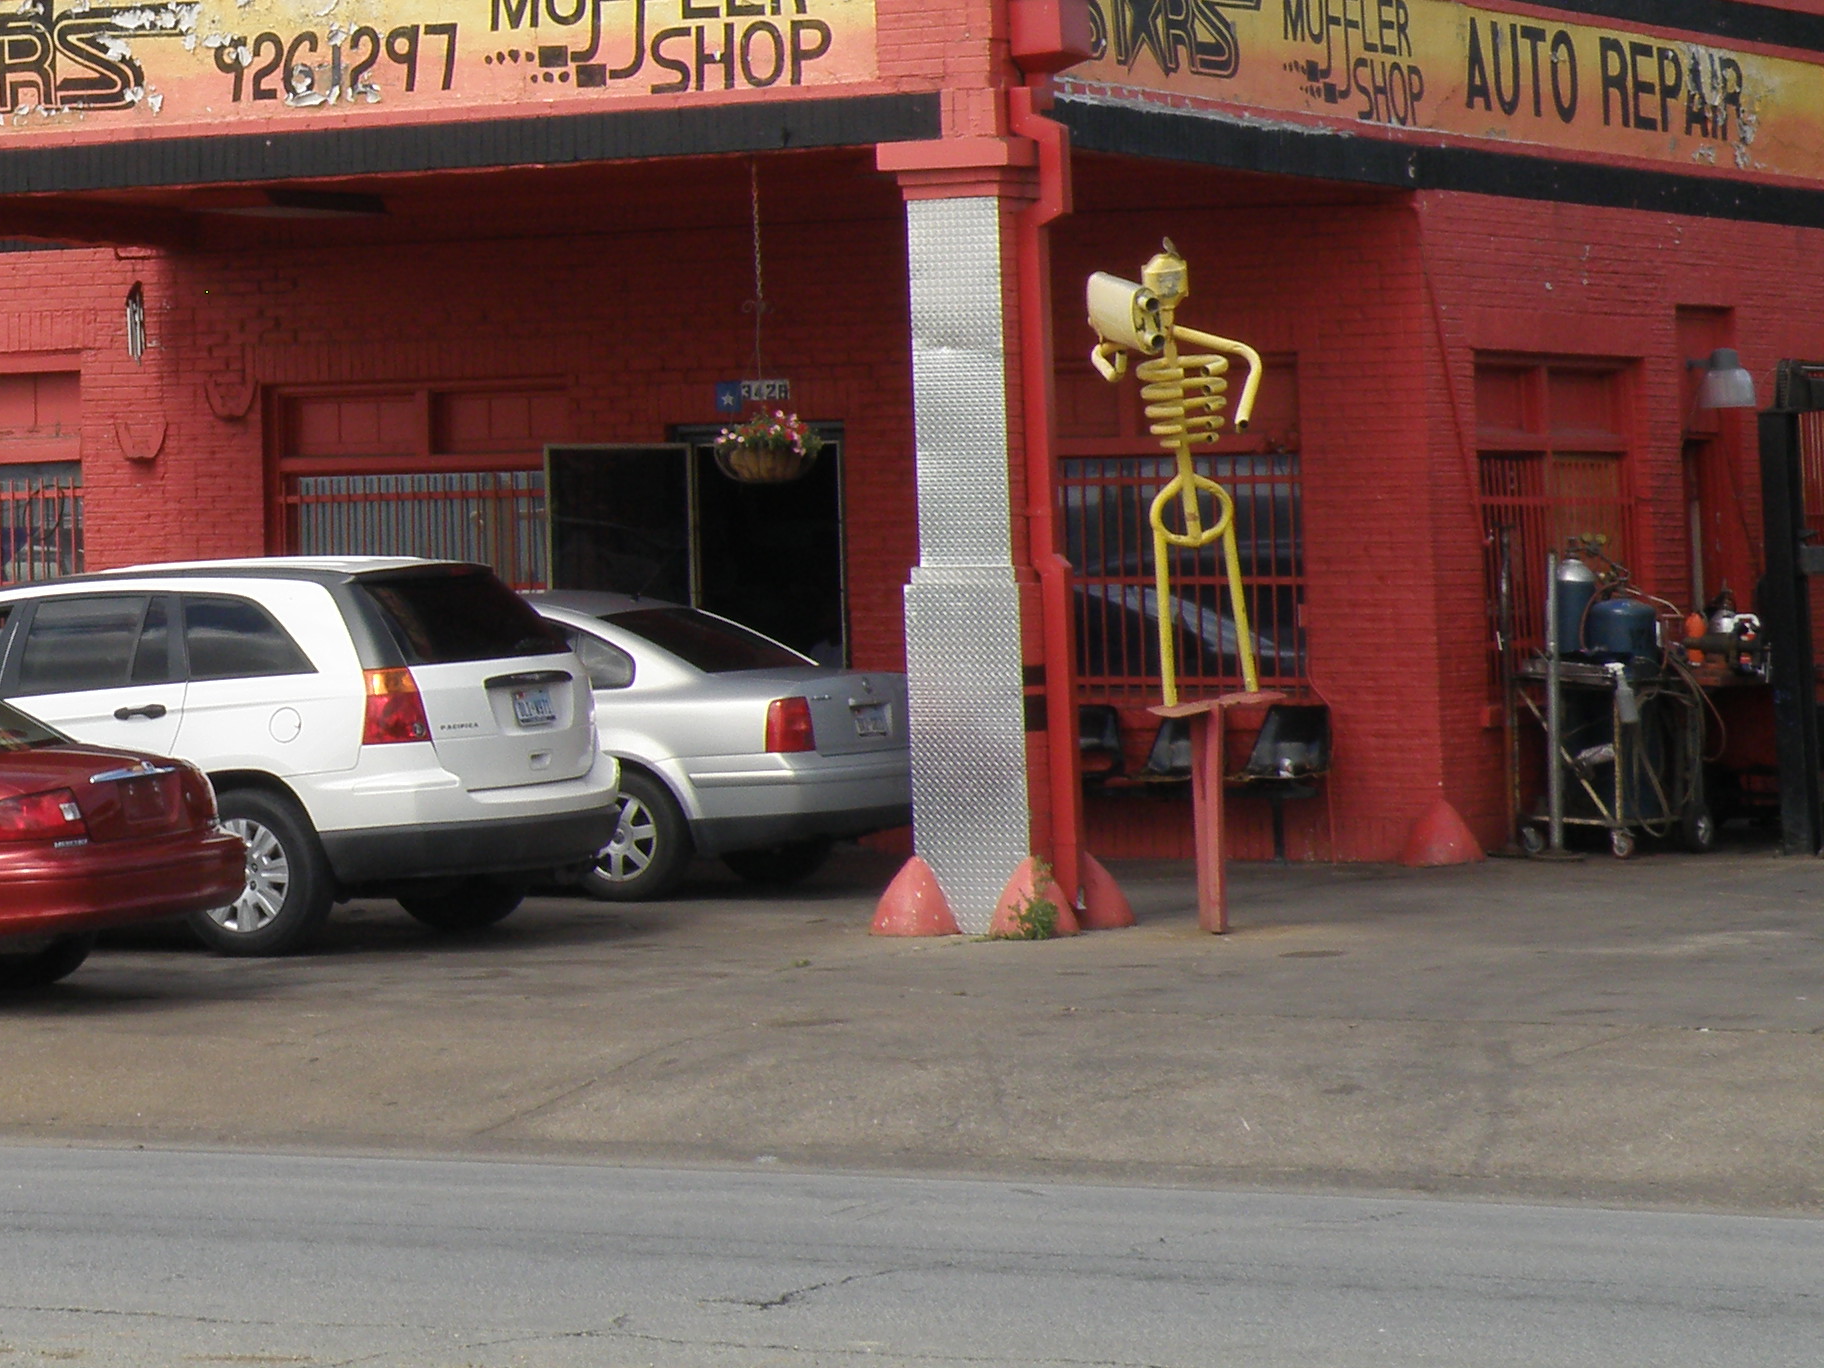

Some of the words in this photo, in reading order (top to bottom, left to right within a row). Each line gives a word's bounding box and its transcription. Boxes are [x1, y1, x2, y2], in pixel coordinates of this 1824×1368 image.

[650, 19, 833, 95] SHOP
[1353, 57, 1425, 127] SHOP
[1465, 16, 1578, 124] AUTO
[1599, 36, 1754, 146] REPAIR
